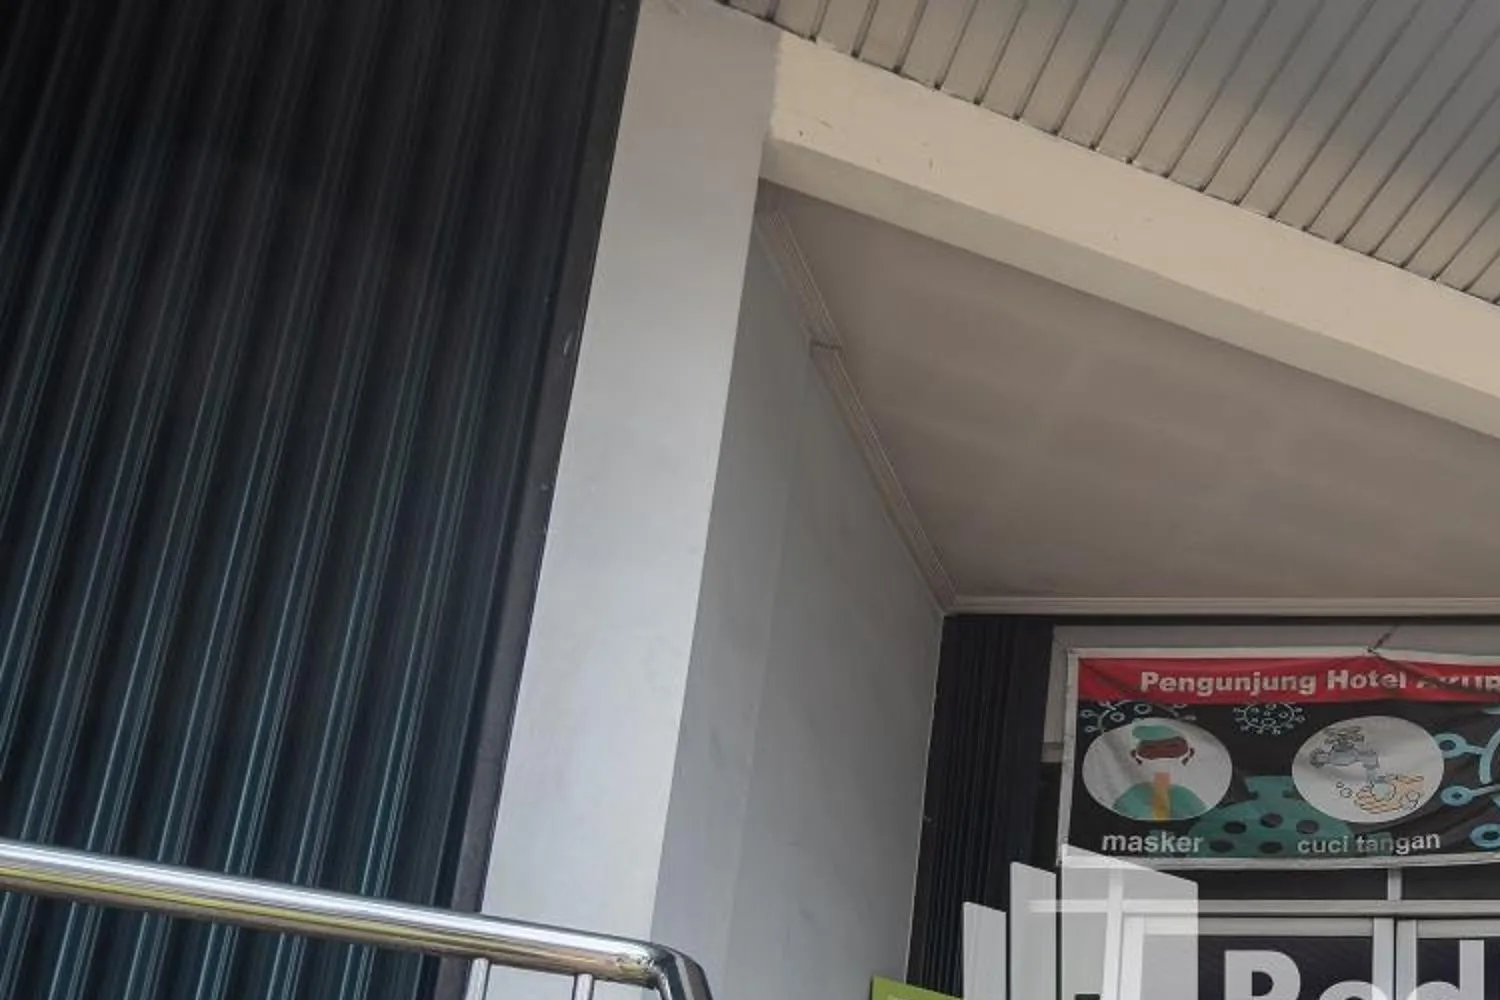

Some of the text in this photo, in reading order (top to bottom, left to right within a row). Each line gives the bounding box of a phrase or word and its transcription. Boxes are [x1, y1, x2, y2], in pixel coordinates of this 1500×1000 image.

[1140, 671, 1317, 696] Pengunjung
[1327, 669, 1407, 691] Hotel
[1101, 831, 1203, 853] masker
[1297, 832, 1441, 855] cuci tangan
